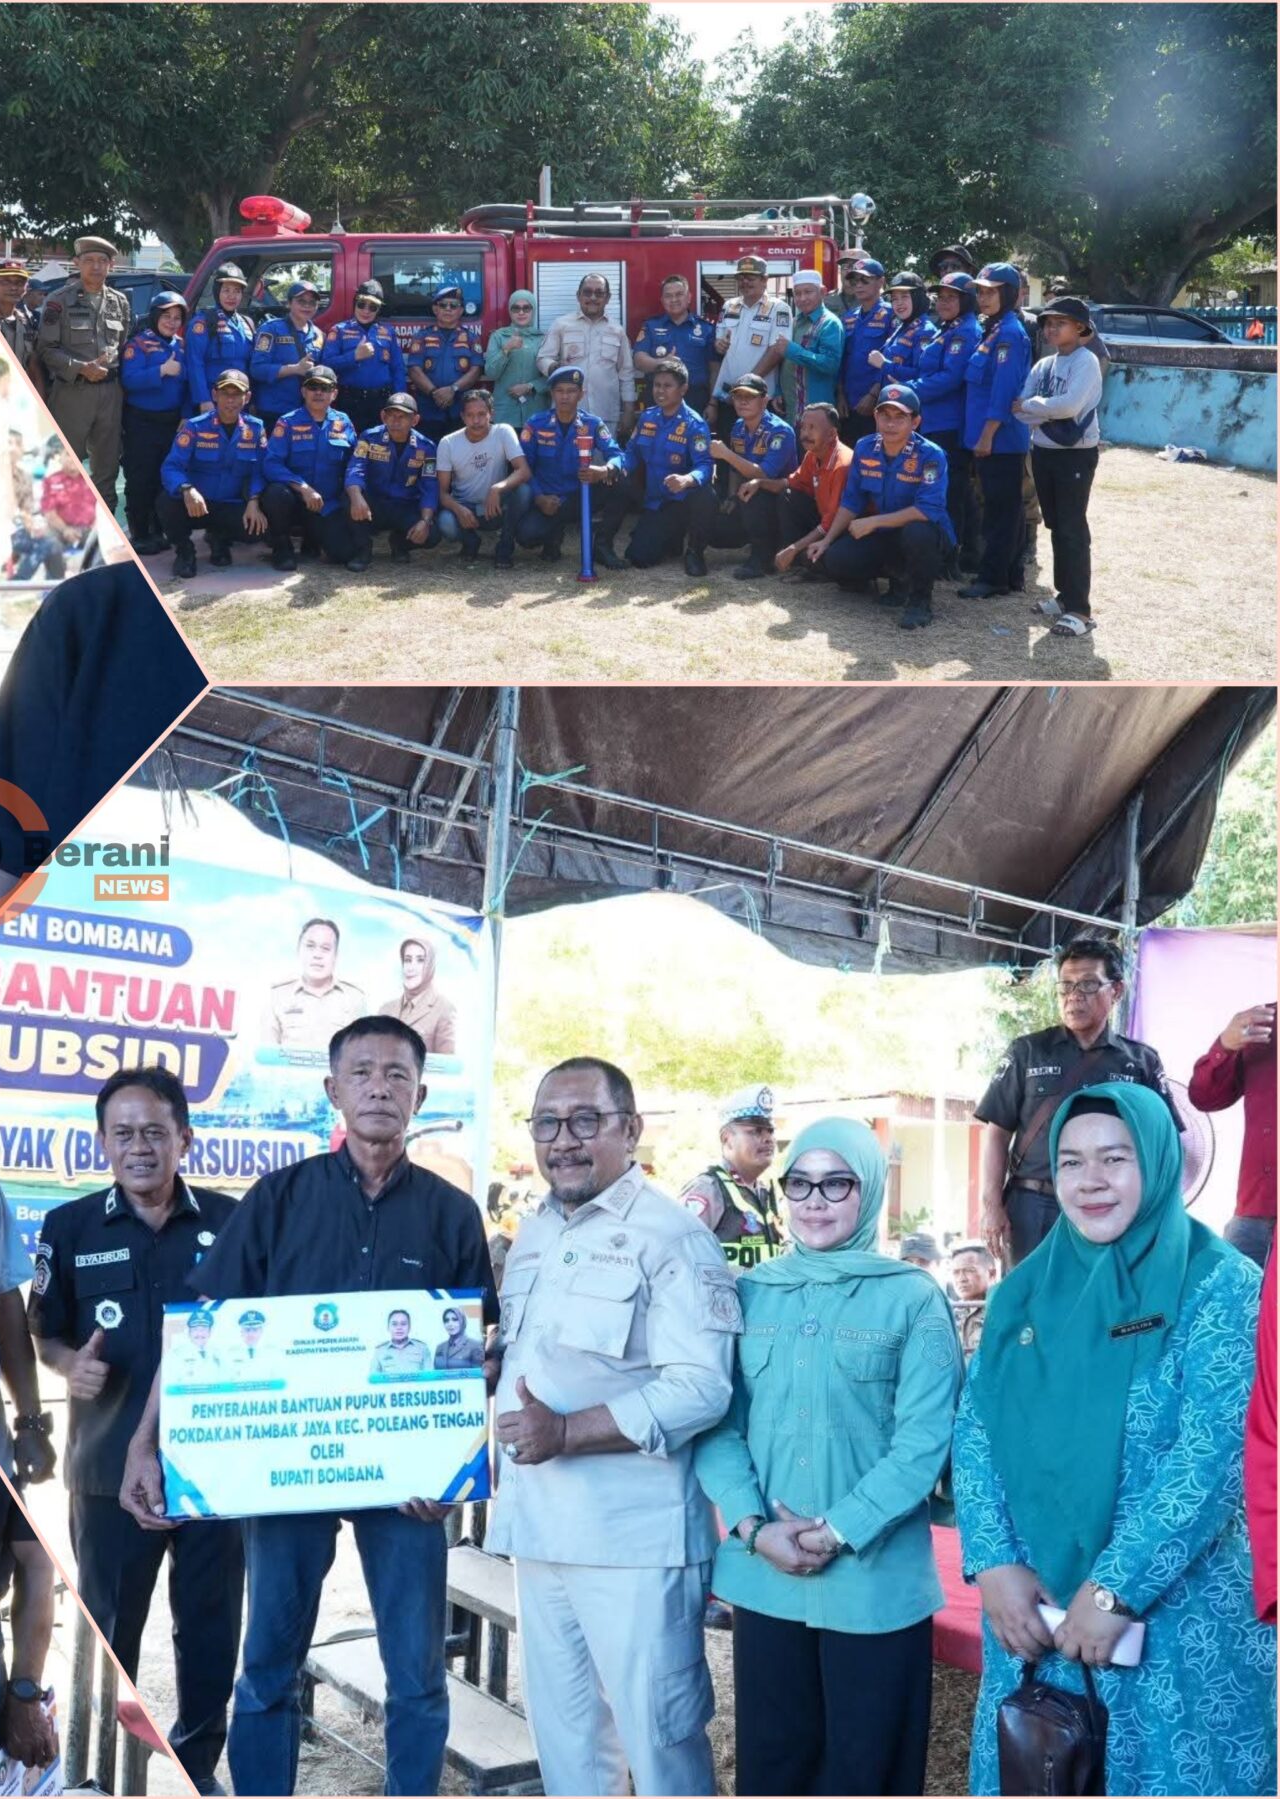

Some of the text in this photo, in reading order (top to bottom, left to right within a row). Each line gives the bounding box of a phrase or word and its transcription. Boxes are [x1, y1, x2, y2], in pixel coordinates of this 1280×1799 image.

[46, 918, 175, 958] BOMBANA
[191, 1388, 463, 1420] PENYERAHAN BANTUAN PUPUK BERSUBSIDI
[168, 1411, 486, 1445] POKDAKAN TAMBAK JAYA KEC. POLEANG TENGAH
[309, 1443, 345, 1461] OLEH
[270, 1464, 385, 1487] BUPATI BOMBANA
